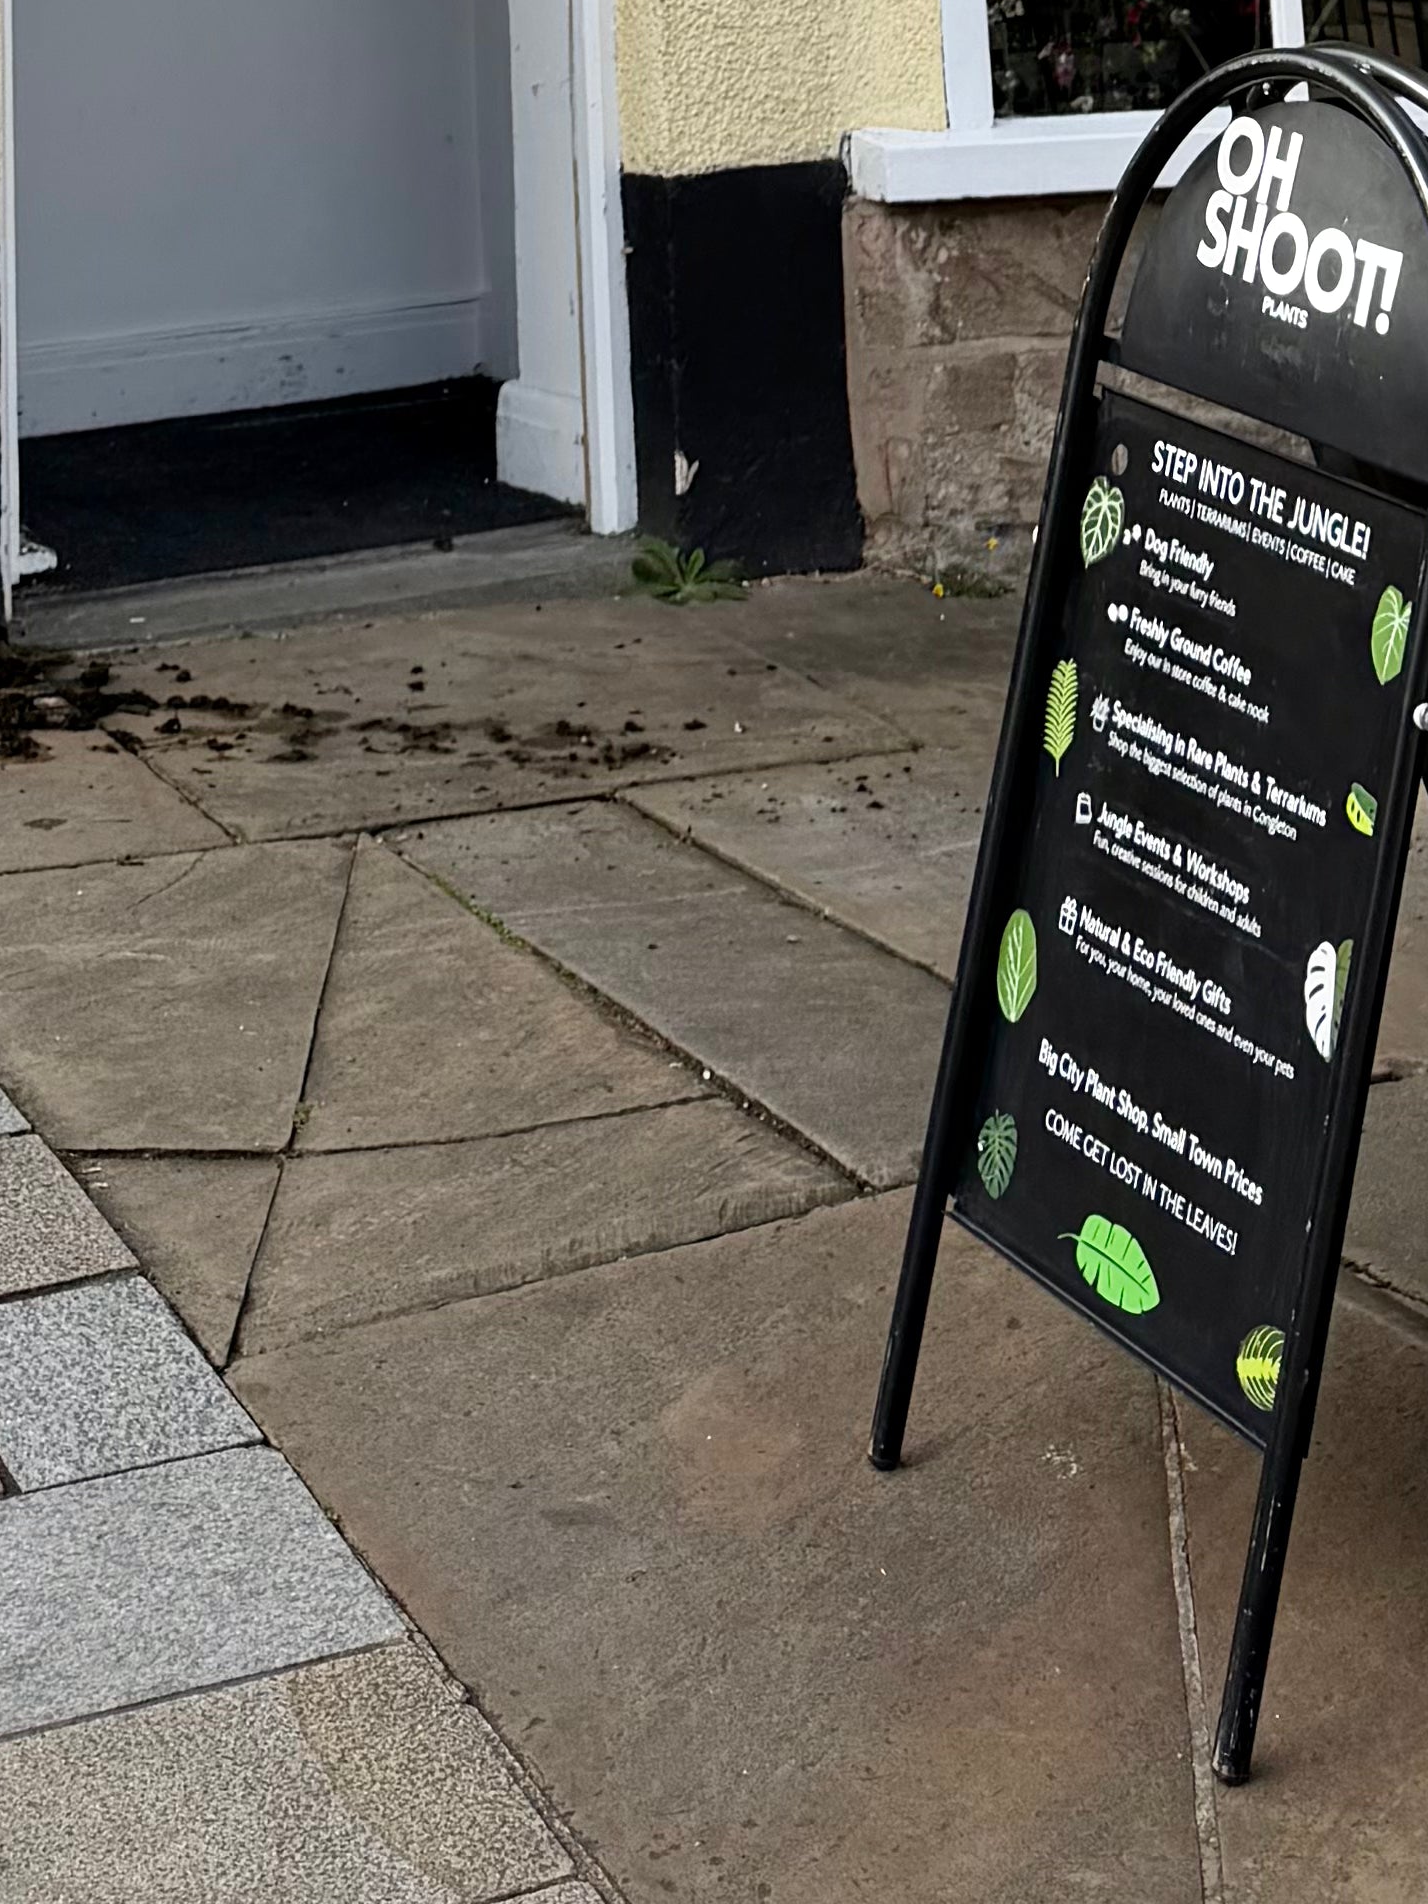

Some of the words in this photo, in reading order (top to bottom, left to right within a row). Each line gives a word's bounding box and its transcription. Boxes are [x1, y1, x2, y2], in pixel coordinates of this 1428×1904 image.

[1217, 115, 1304, 212] OH
[1196, 188, 1404, 335] SHOOT!
[1261, 295, 1309, 329] PLANTS
[1144, 527, 1167, 563] Dog
[1169, 538, 1214, 581] Friendly
[1151, 440, 1197, 484] STEP
[1198, 459, 1245, 505] INTO
[1249, 478, 1287, 524] THE
[1287, 496, 1372, 560] JUNGLE!
[1159, 488, 1191, 515] PLANTS
[1197, 502, 1247, 538] TERRARIUMS
[1251, 527, 1286, 555] EVENTS
[1290, 543, 1326, 572] COFFEE
[1330, 561, 1356, 586] CAKE
[1124, 638, 1147, 666] Enjoy
[1147, 652, 1162, 669] our
[1162, 658, 1171, 674] in
[1172, 665, 1192, 685] store
[1192, 674, 1218, 698] coffee
[1218, 685, 1226, 703] &
[1227, 693, 1247, 713] cake
[1246, 702, 1270, 723] nook
[1129, 607, 1170, 648] Freshly
[1170, 627, 1213, 667] Ground
[1212, 648, 1252, 686] Coffee
[1108, 730, 1129, 757] Shop
[1129, 741, 1143, 762] the
[1142, 747, 1172, 777] biggest
[1172, 766, 1207, 796] selection
[1207, 783, 1219, 800] of
[1217, 790, 1242, 813] plants
[1243, 800, 1252, 818] in
[1252, 805, 1297, 841] Congleton
[1112, 699, 1173, 755] Specialising
[1175, 733, 1186, 756] in
[1187, 737, 1213, 770] Rare
[1214, 751, 1249, 789] Plants
[1250, 771, 1261, 795] &
[1266, 776, 1326, 827] Terrariums
[1093, 829, 1110, 855] Fun,
[1111, 843, 1142, 870] creative
[1141, 859, 1173, 889] sessions
[1174, 874, 1188, 895] for
[1186, 886, 1219, 914] children
[1219, 903, 1237, 924] and
[1236, 912, 1262, 938] adults
[1097, 801, 1133, 840] Jungle
[1134, 820, 1171, 860] Events
[1172, 843, 1182, 868] &
[1186, 848, 1250, 905] Workshops
[1076, 935, 1089, 955] For
[1088, 948, 1107, 968] you,
[1106, 958, 1126, 978] your
[1126, 966, 1152, 996] home,
[1151, 985, 1173, 1006] your
[1172, 993, 1196, 1021] loved
[1196, 1011, 1216, 1034] ones
[1216, 1024, 1235, 1044] and
[1233, 1034, 1254, 1056] even
[1252, 1046, 1276, 1068] your
[1274, 1058, 1295, 1080] pets
[1079, 905, 1122, 949] Natural
[1121, 931, 1131, 956] &
[1133, 937, 1155, 969] Eco
[1155, 950, 1201, 1001] Friendly
[1202, 979, 1232, 1015] Gifts
[1038, 1037, 1059, 1076] Big
[1059, 1052, 1084, 1092] City
[1084, 1068, 1116, 1109] Plant
[1116, 1089, 1149, 1134] Shop,
[1151, 1112, 1187, 1155] Small
[1187, 1133, 1224, 1180] Town
[1223, 1158, 1264, 1206] Prices
[1045, 1108, 1083, 1151] COME
[1083, 1134, 1111, 1167] GET
[1110, 1151, 1143, 1189] LOST
[1142, 1172, 1158, 1201] IN
[1159, 1183, 1187, 1220] THE
[1185, 1200, 1239, 1256] LEAVES!
